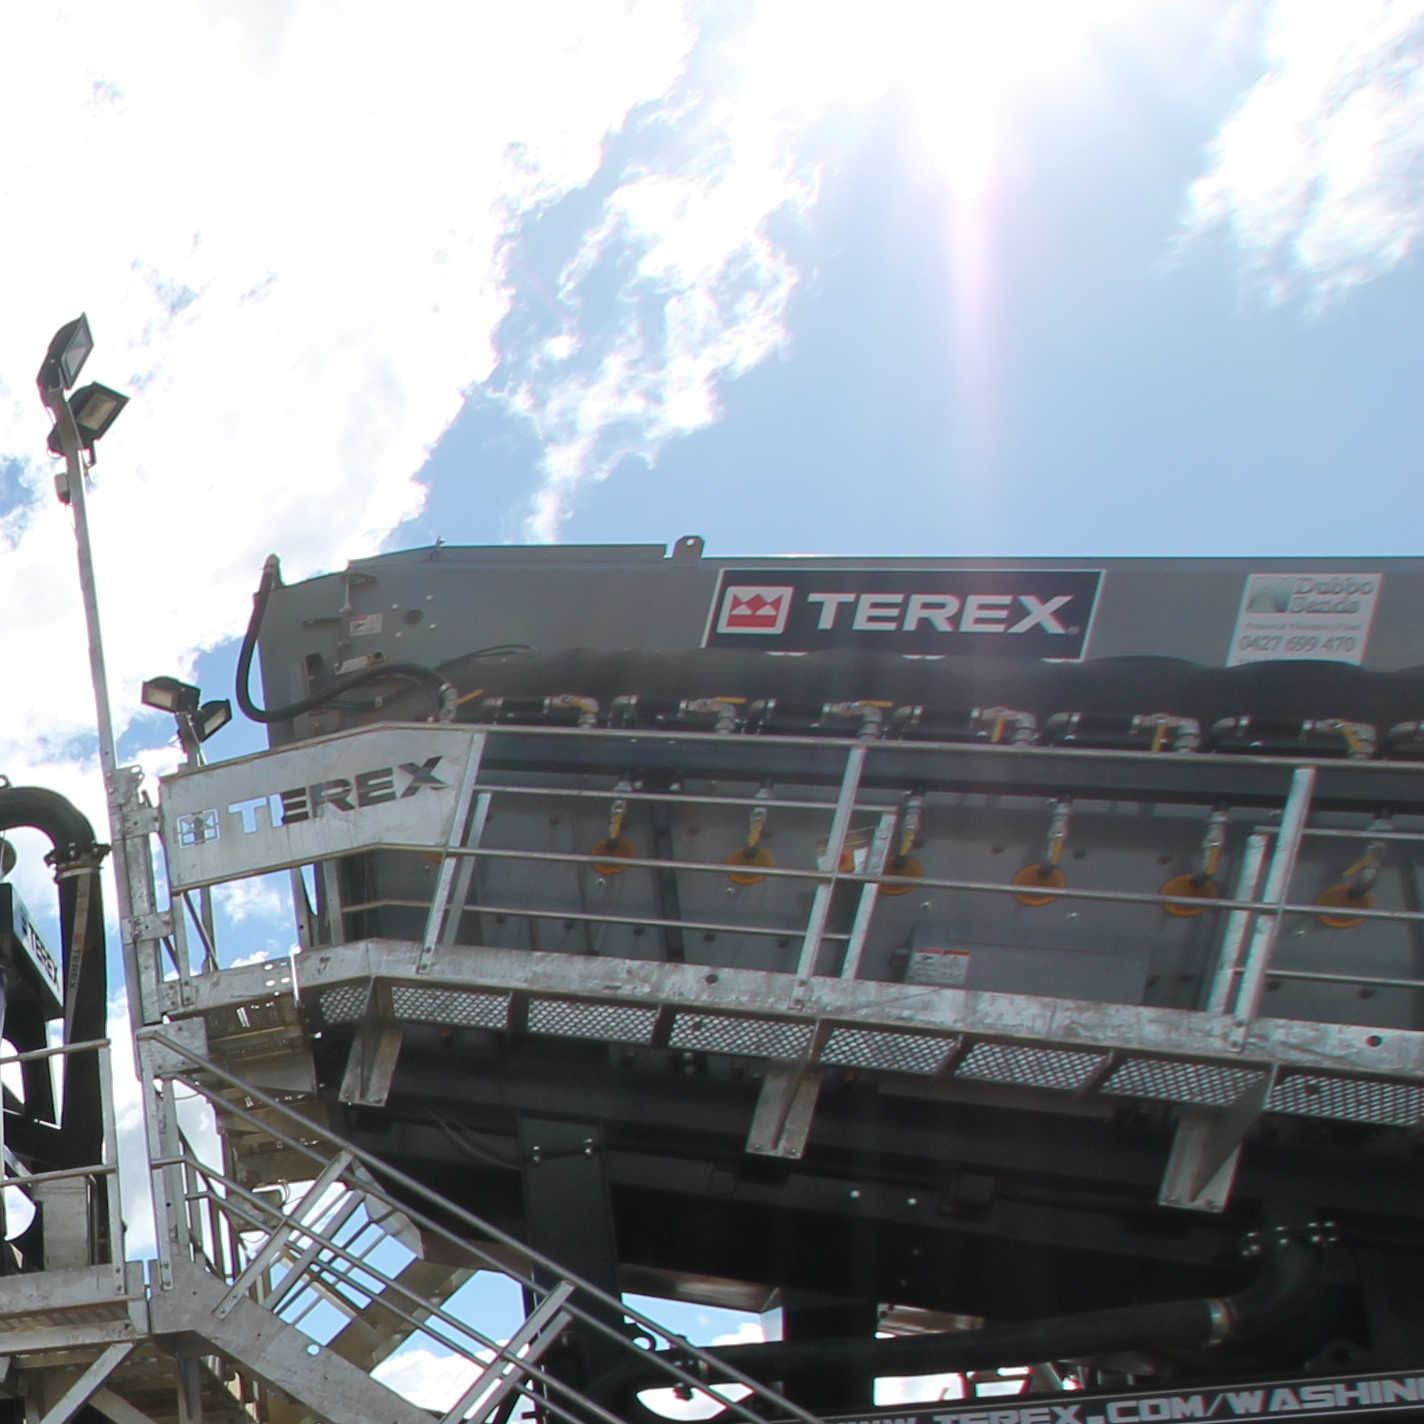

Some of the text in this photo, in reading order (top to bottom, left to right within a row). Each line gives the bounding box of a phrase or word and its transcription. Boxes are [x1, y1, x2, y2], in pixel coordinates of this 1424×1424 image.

[1289, 595, 1360, 613] Sands
[1294, 576, 1375, 595] Dubbo
[807, 592, 1075, 634] TEREX
[1239, 634, 1284, 652] 0427
[1320, 634, 1356, 652] 470
[228, 756, 451, 834] TEREX
[27, 921, 60, 992] TEREX
[69, 947, 83, 990] TEREX
